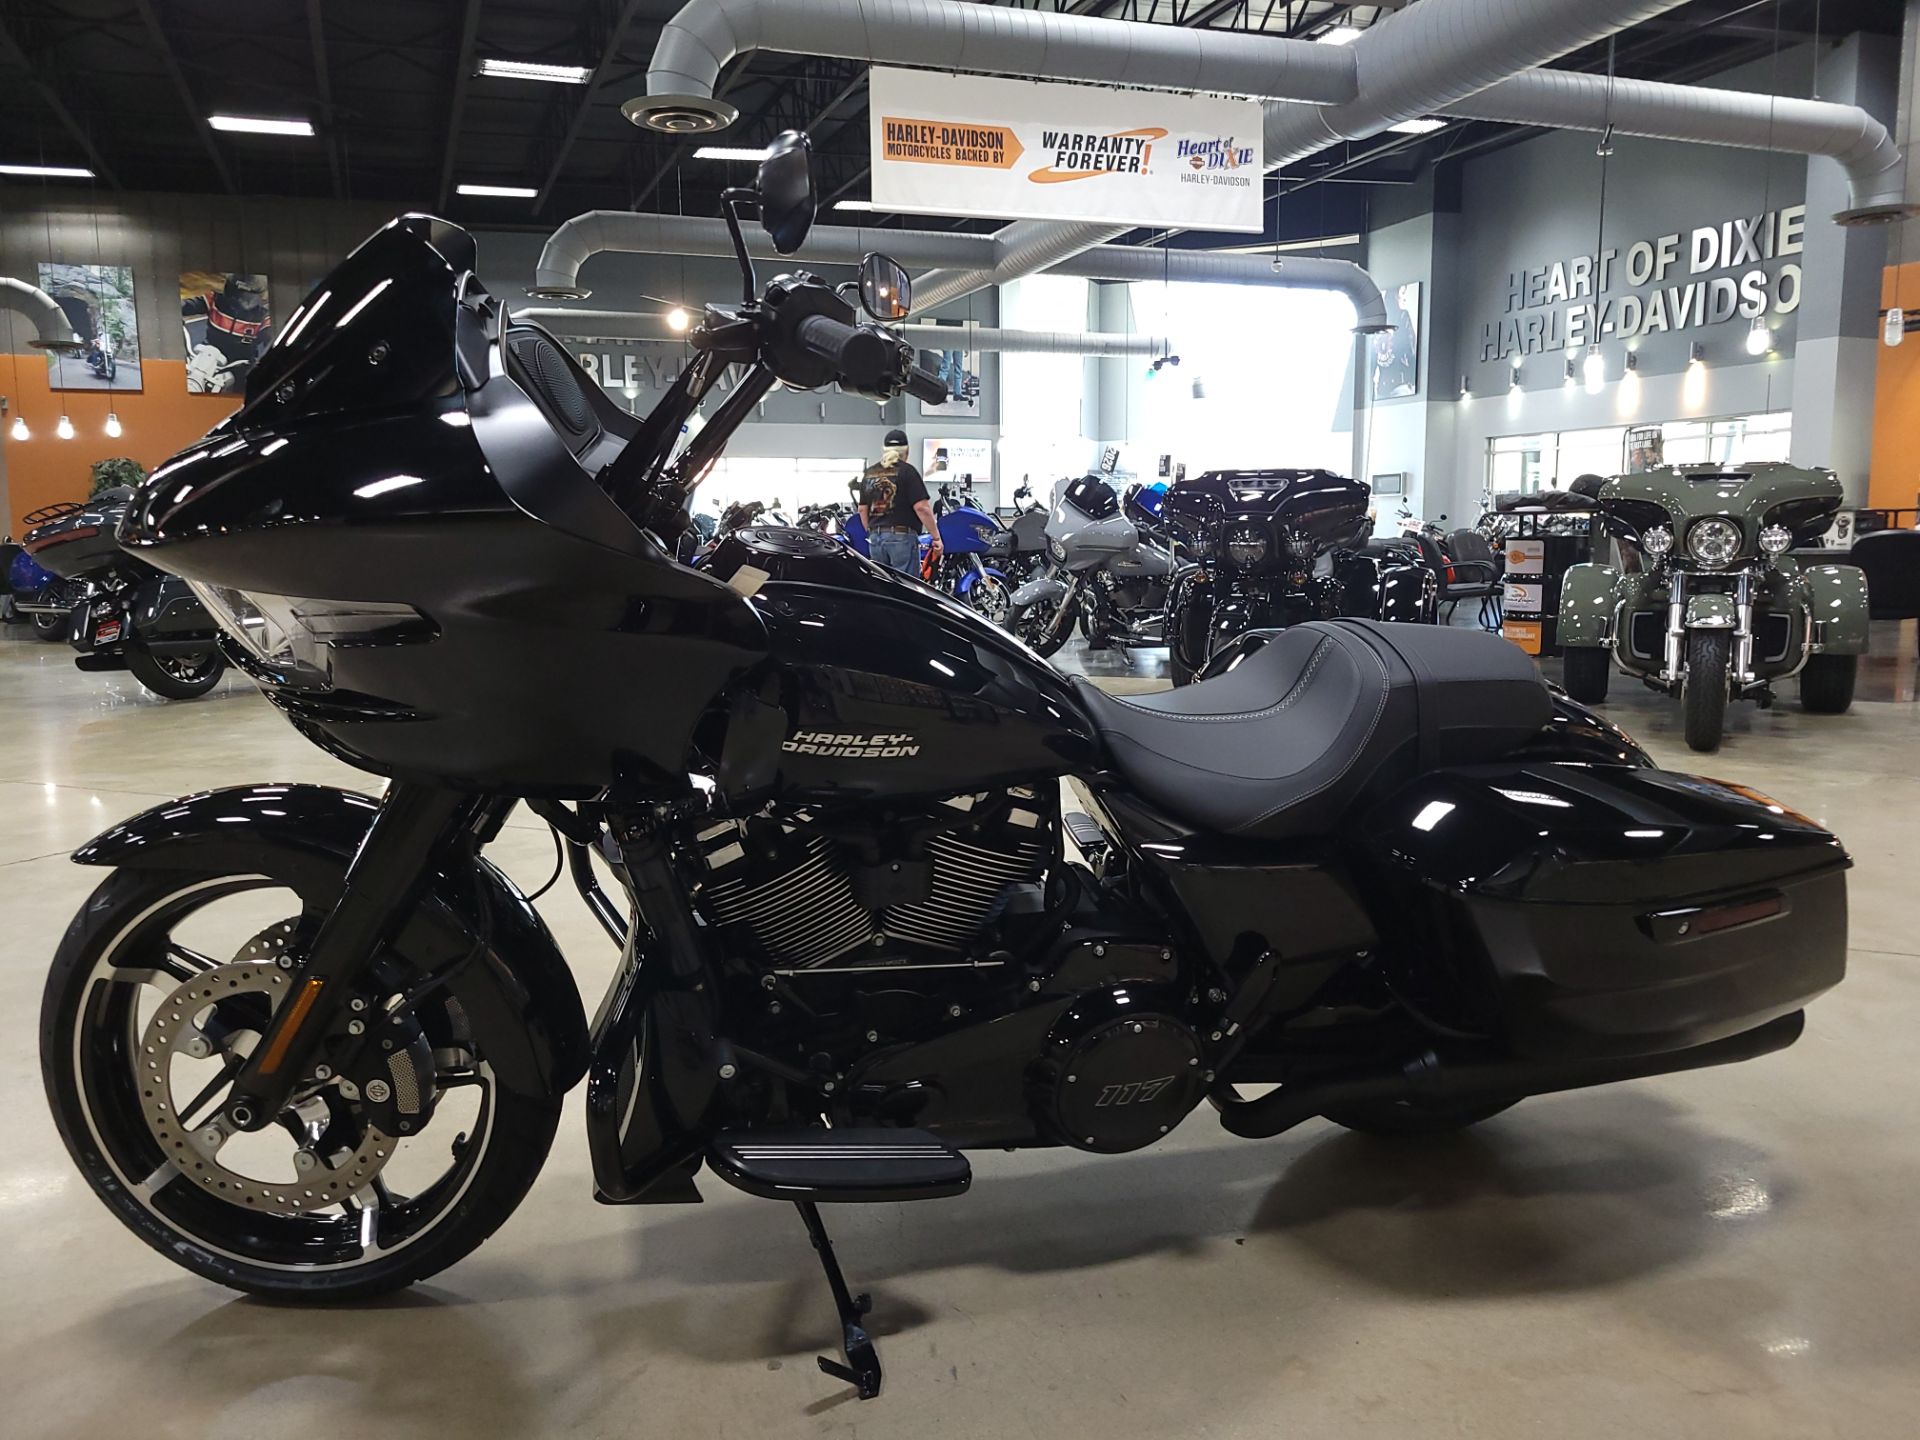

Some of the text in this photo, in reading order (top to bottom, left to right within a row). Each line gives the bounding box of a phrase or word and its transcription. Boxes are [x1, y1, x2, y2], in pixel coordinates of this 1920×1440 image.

[887, 123, 1004, 149] HARLEY-DAVIDSON
[1042, 131, 1145, 155] WARRANTY
[1177, 136, 1234, 158] Heart of
[887, 143, 1005, 164] MOTORCYCLES BACKED BY
[1055, 145, 1152, 175] FOREVER!
[1207, 147, 1253, 170] DIXIE
[1181, 173, 1250, 187] HARLEY-DAVIDSON
[1504, 204, 1806, 313] HEART OF DIXIE
[1480, 263, 1803, 361] HARLEY-DAVIDSO
[781, 741, 920, 758] DAVIDSON
[792, 730, 915, 746] HARLEY-
[1095, 1075, 1176, 1107] 117
